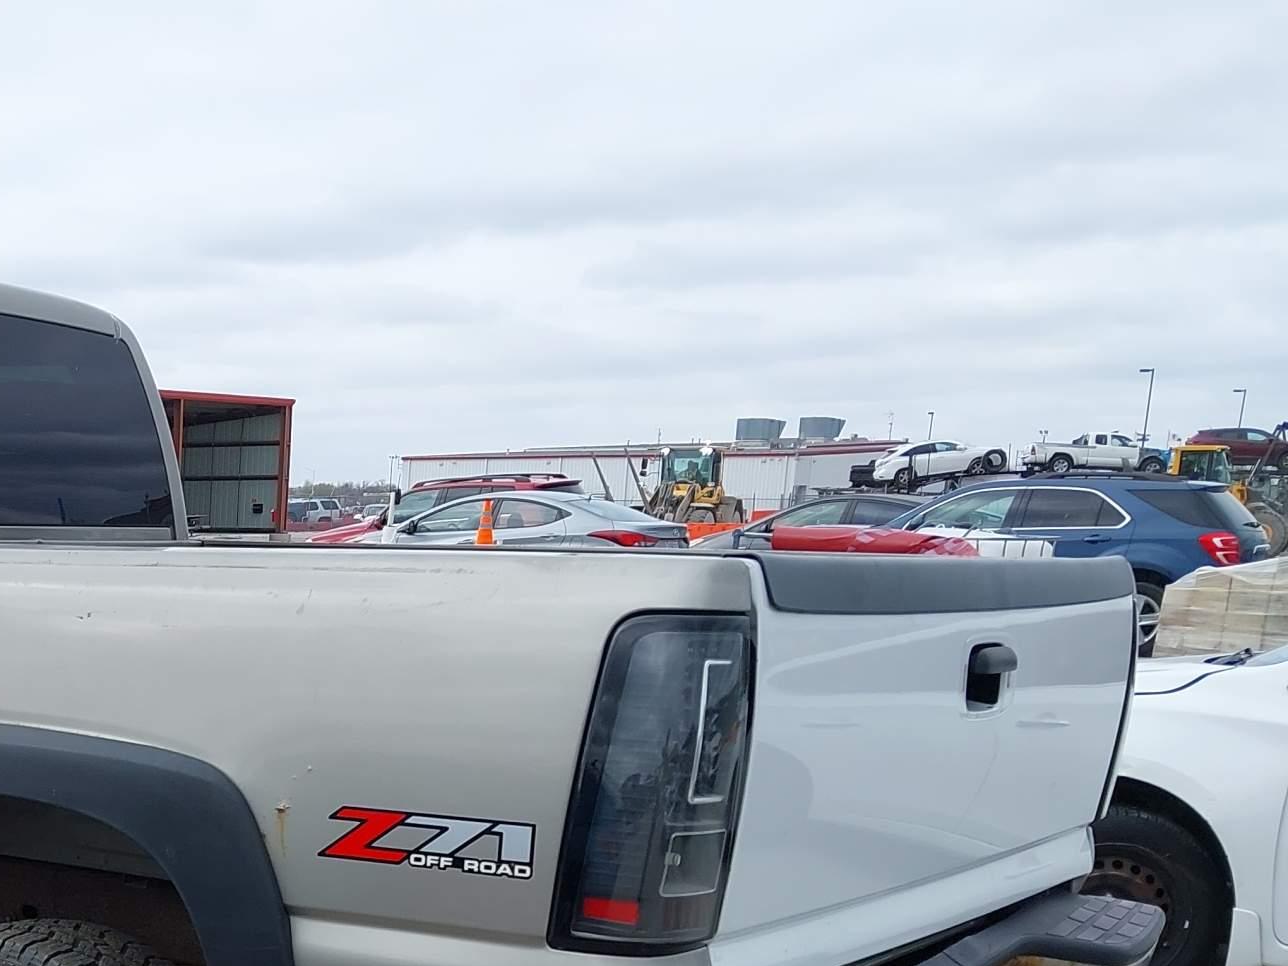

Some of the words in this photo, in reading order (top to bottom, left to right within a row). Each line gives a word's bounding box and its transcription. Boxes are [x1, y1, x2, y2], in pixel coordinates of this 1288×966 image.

[317, 805, 537, 865] Z71
[409, 853, 453, 869] OFF
[463, 858, 532, 878] ROAD
